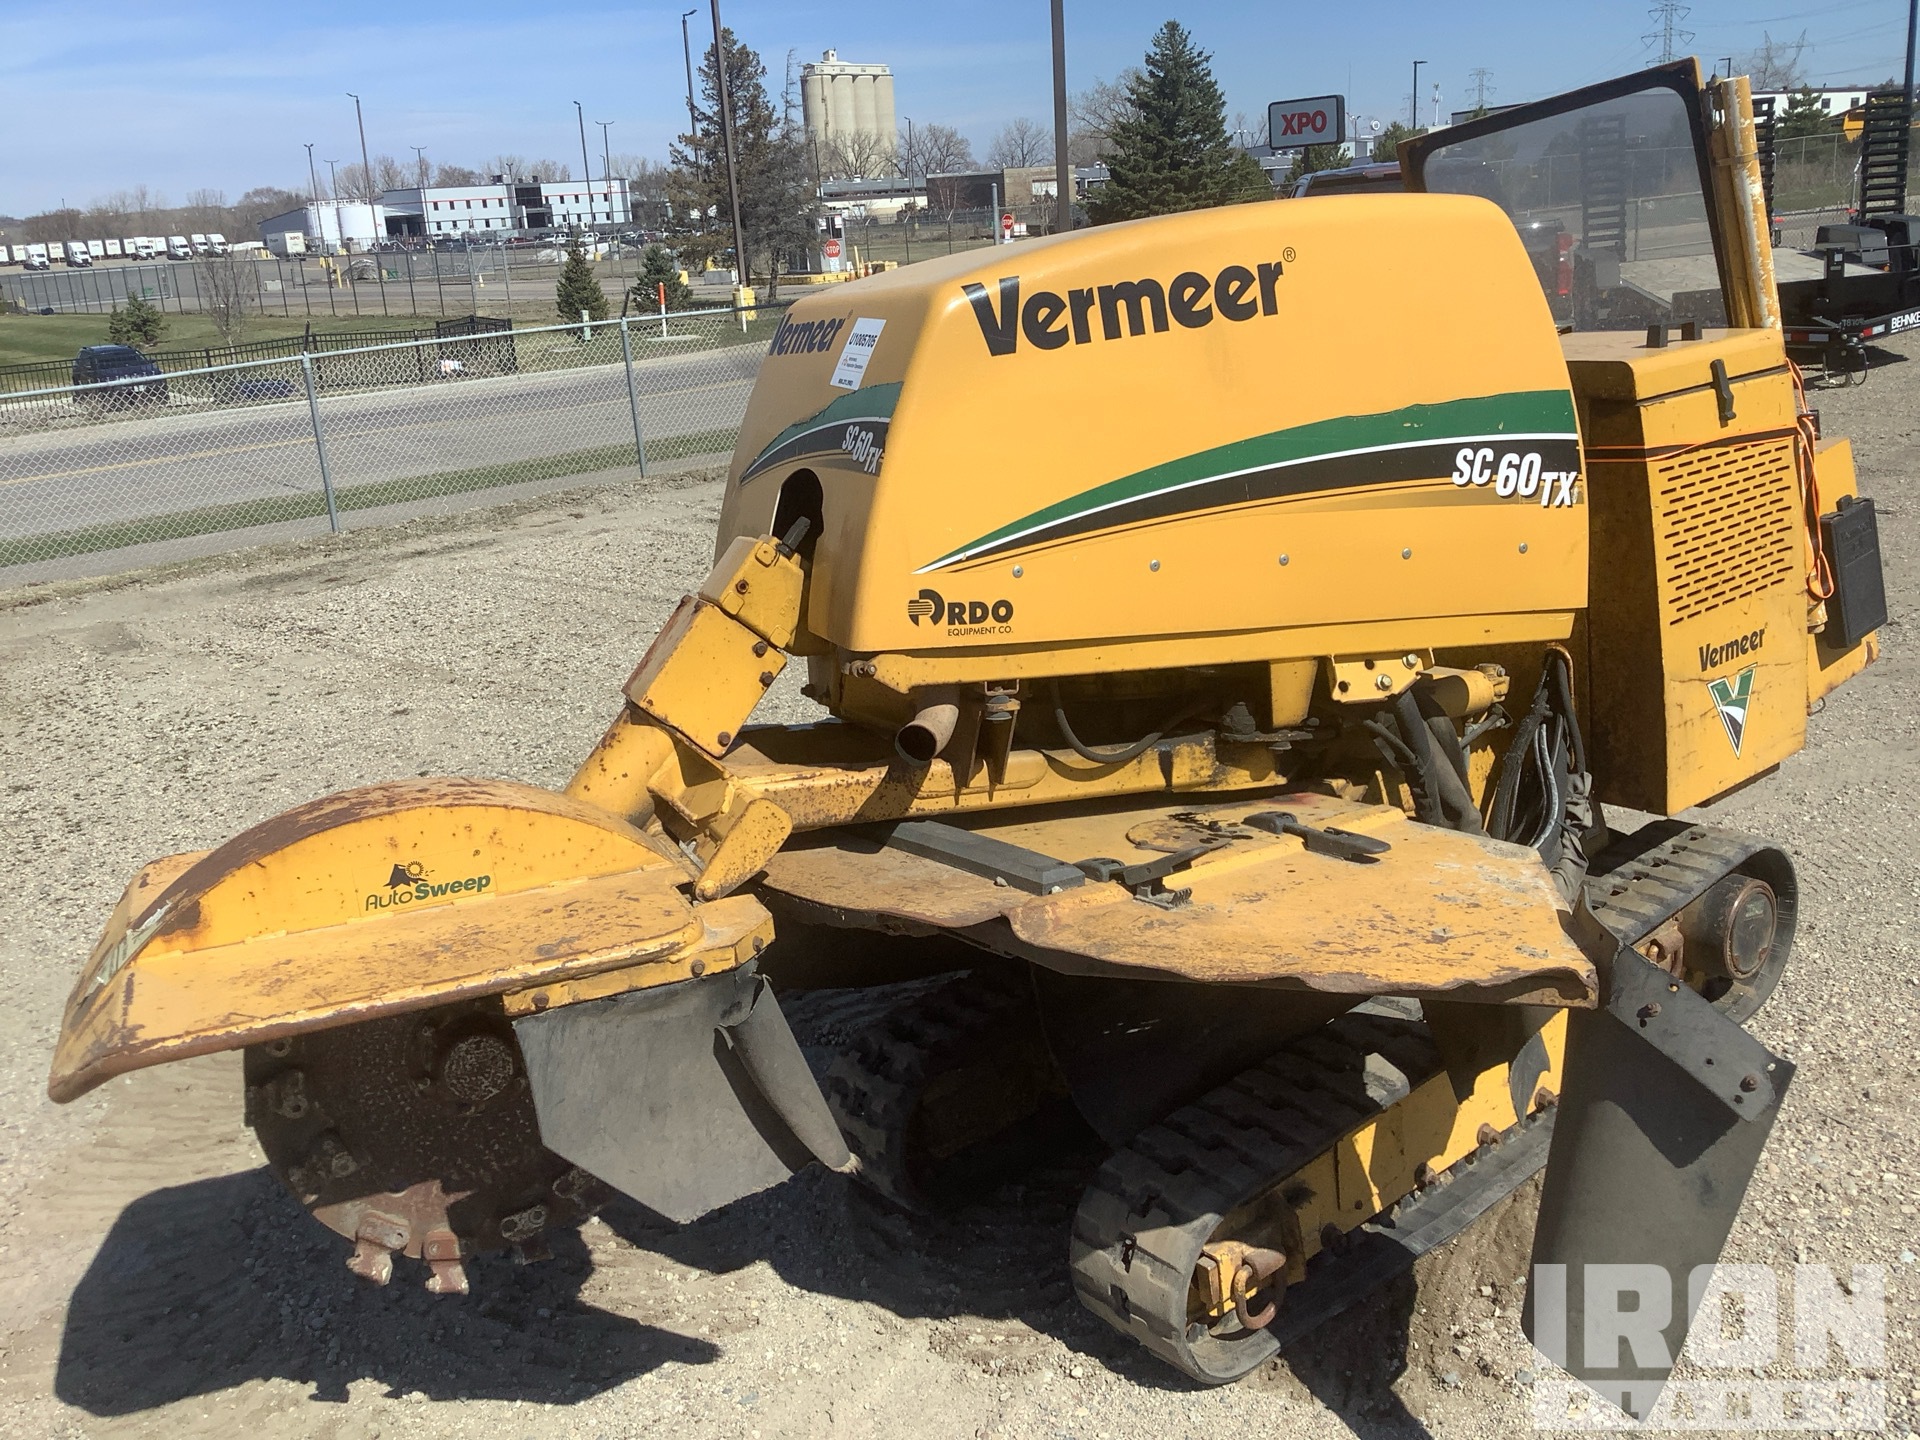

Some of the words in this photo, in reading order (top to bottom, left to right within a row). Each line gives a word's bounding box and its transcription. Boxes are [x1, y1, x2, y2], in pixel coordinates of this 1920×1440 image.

[1281, 110, 1327, 136] XPO
[826, 245, 840, 255] STOP
[768, 312, 846, 356] Vermeer
[947, 626, 997, 637] EQUIPMENT
[998, 625, 1014, 634] CO.
[1698, 627, 1766, 672] Vermeer
